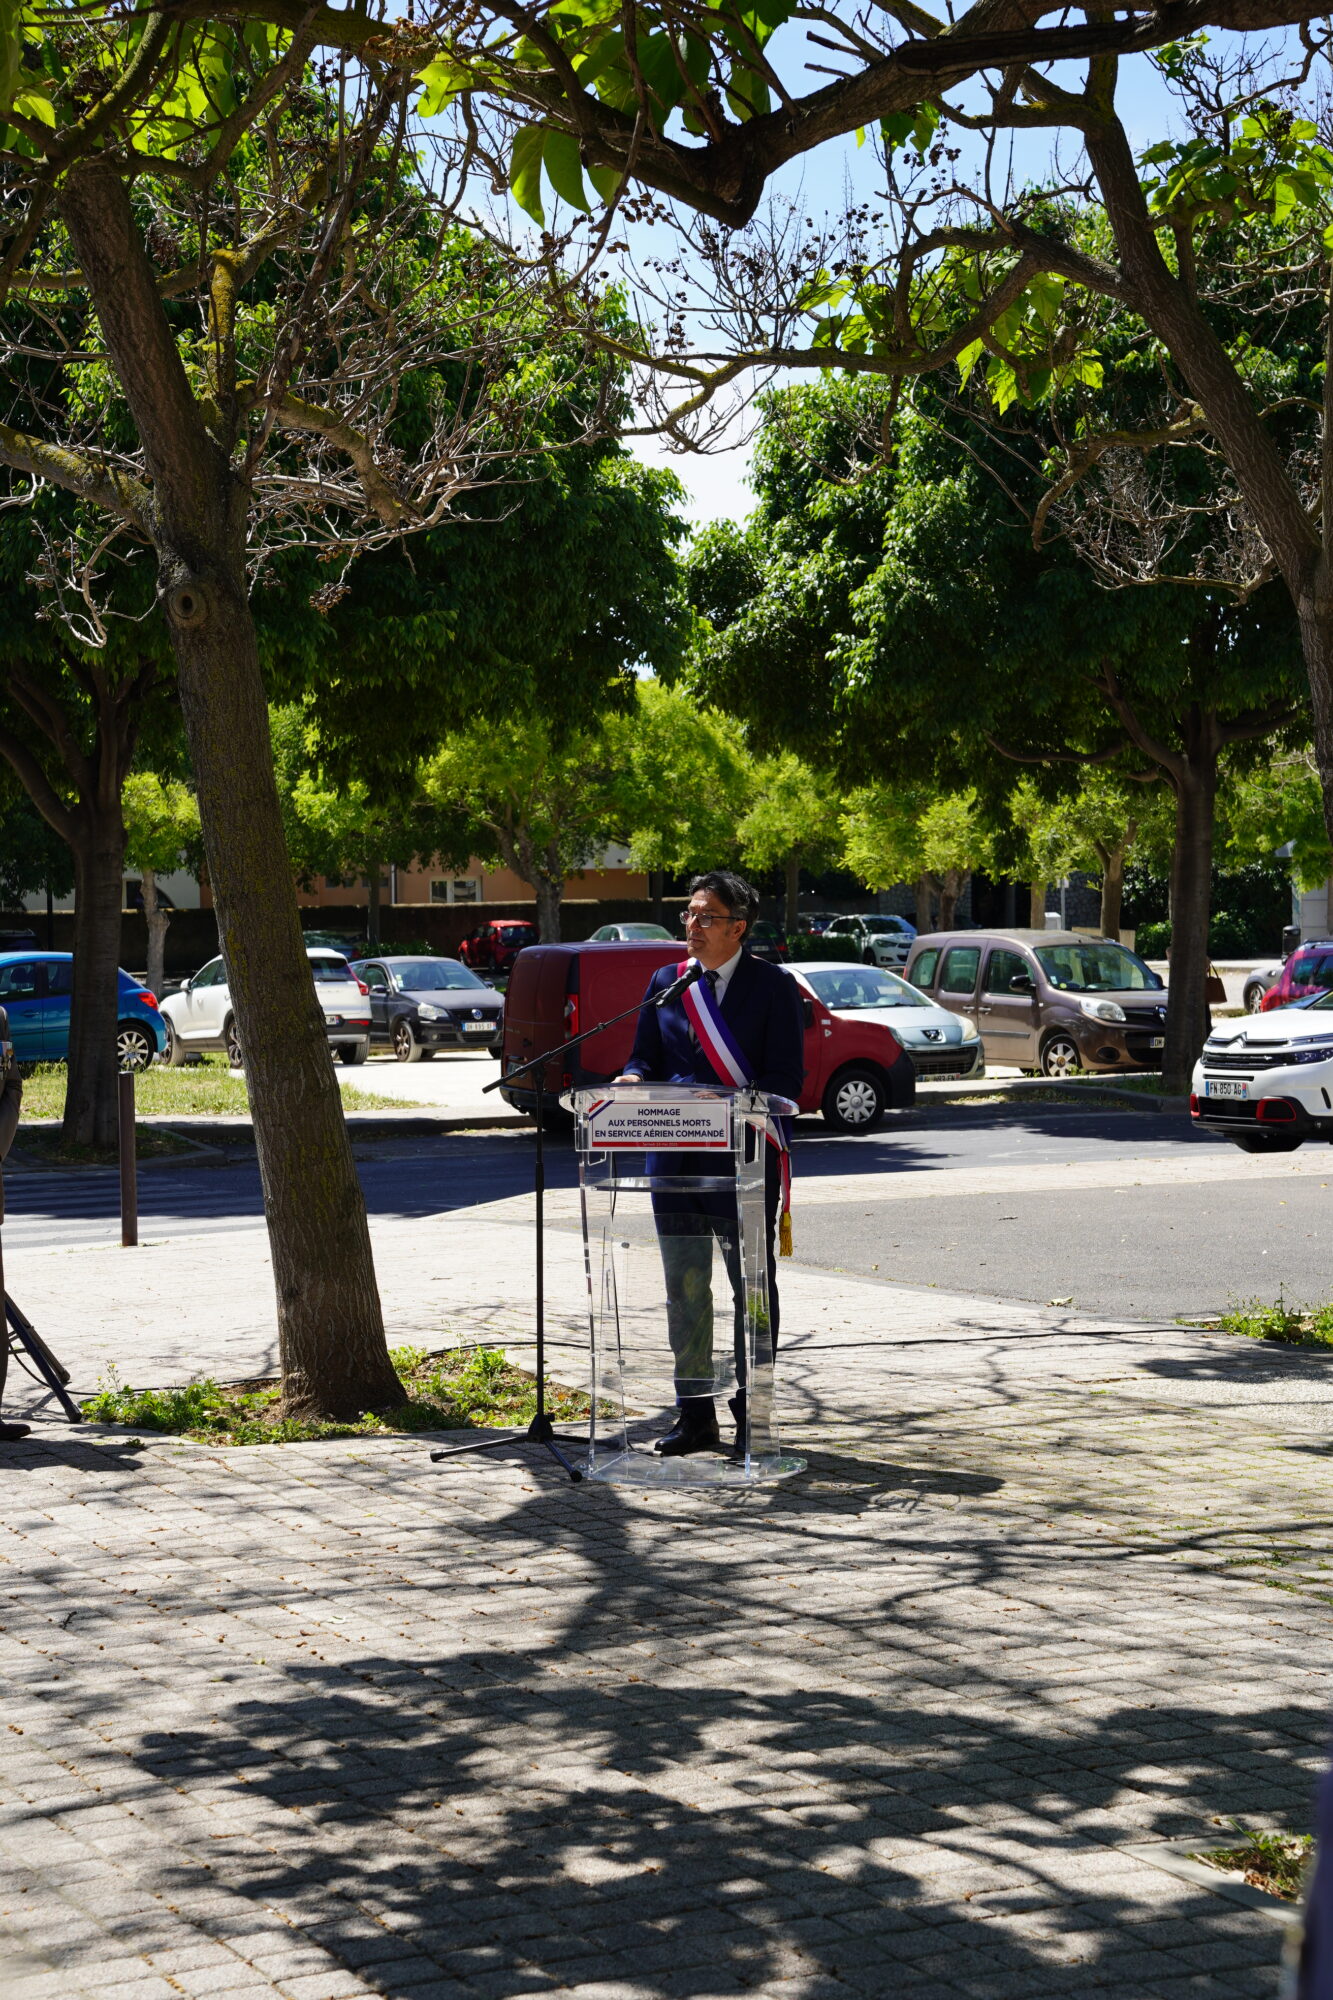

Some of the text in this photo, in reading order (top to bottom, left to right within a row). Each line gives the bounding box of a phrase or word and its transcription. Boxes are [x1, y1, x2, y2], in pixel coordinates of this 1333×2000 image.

[638, 1108, 681, 1116] HOMMAGE
[608, 1119, 711, 1127] AUX PERSONNELS MORTS
[594, 1128, 725, 1138] EN SERVICE AÉRIEN COMMANDÉ
